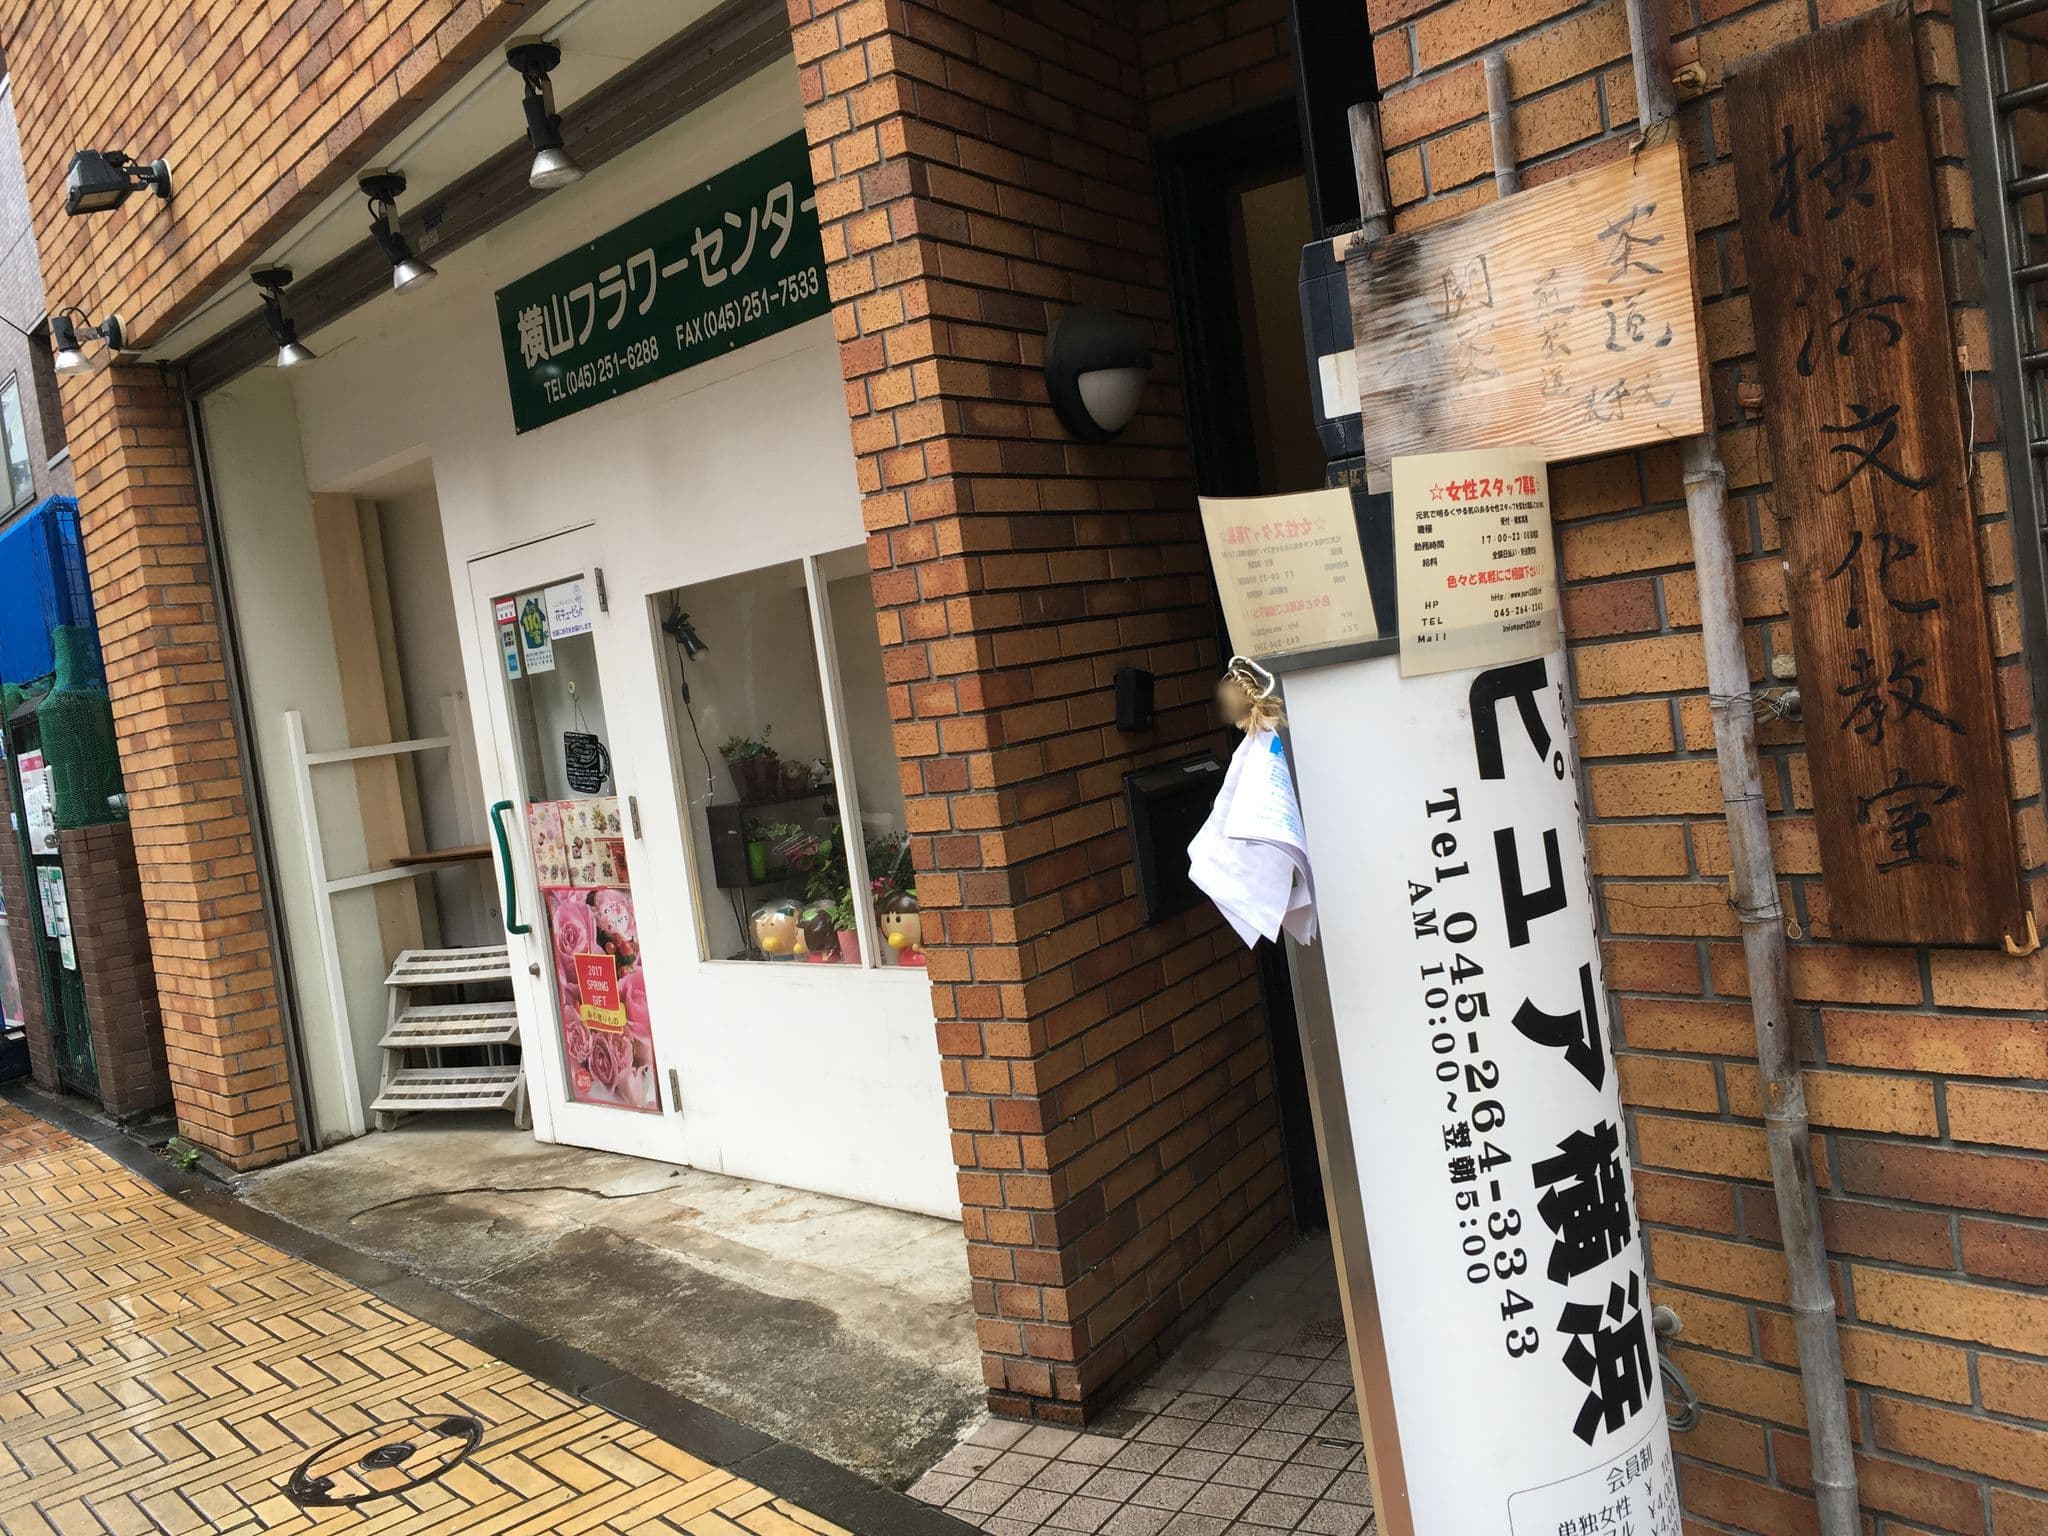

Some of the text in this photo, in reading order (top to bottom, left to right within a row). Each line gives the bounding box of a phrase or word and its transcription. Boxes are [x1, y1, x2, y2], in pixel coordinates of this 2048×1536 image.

[1422, 617, 1444, 627] TEL
[1408, 879, 1440, 940] AM
[587, 980, 609, 992] SPRING
[592, 995, 607, 1007] GIFT
[1443, 911, 1540, 1359] 045-264-3343
[1606, 1442, 1654, 1494] 会員制
